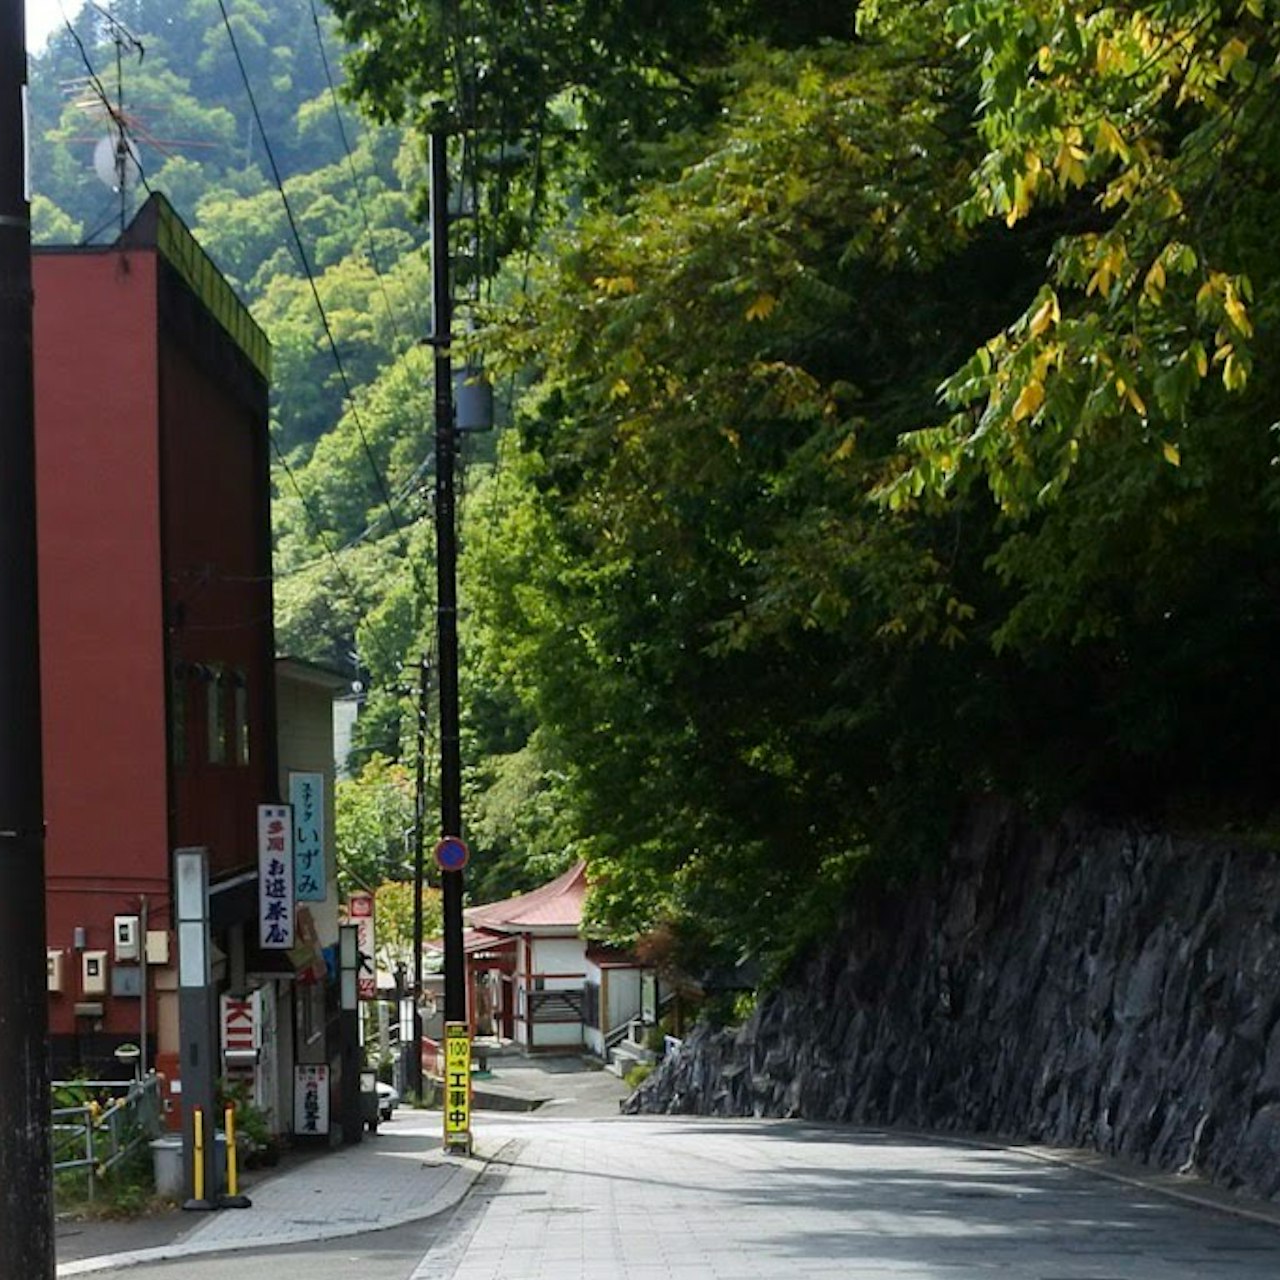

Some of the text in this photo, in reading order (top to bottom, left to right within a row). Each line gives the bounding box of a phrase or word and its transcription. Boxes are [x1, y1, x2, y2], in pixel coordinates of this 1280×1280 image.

[297, 783, 319, 893] スナック いずみ
[450, 1073, 466, 1126] 工事中
